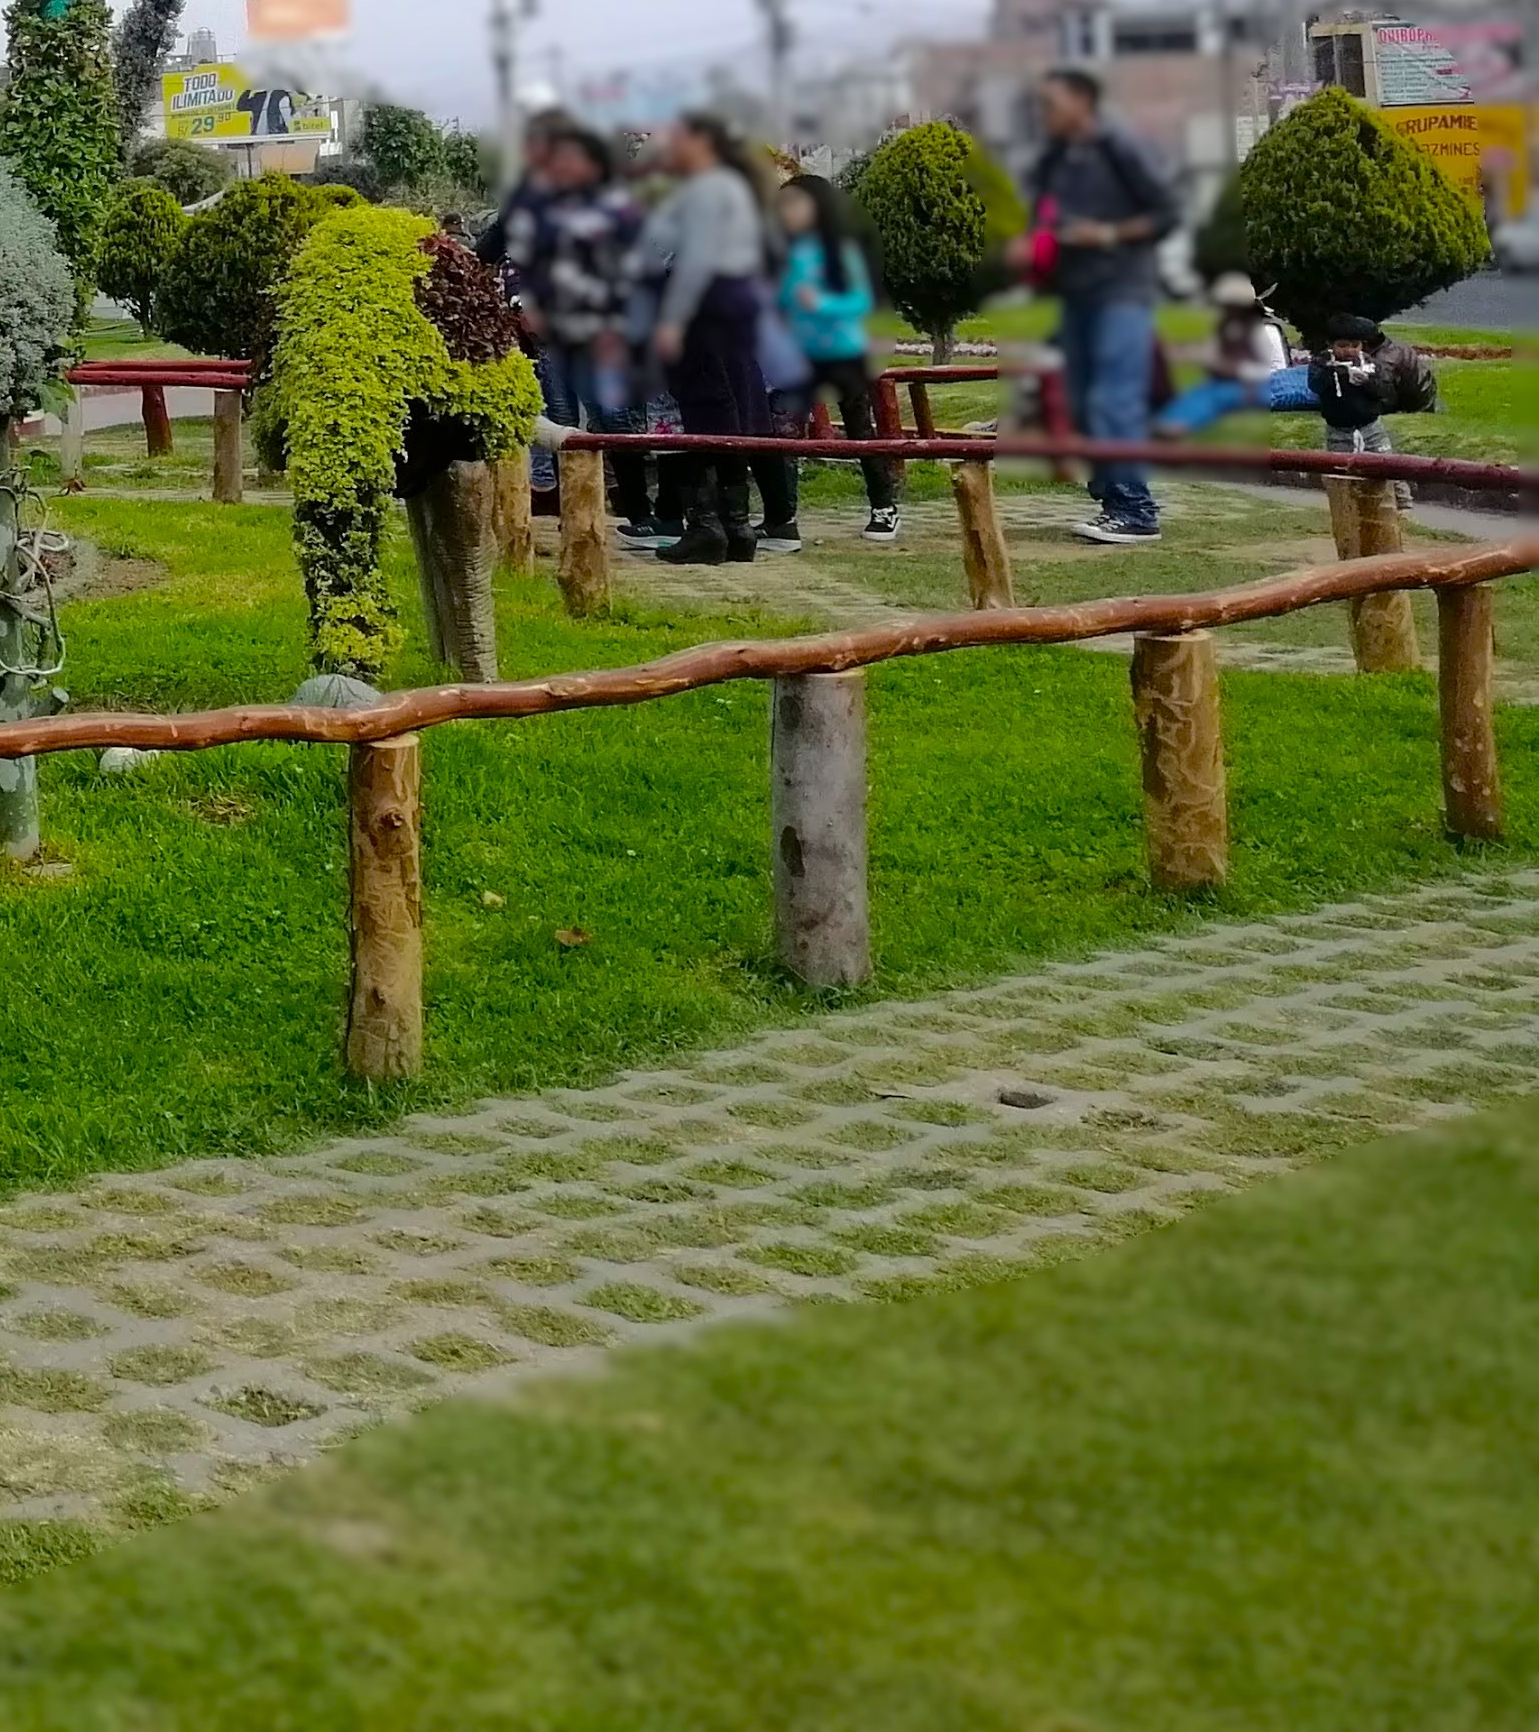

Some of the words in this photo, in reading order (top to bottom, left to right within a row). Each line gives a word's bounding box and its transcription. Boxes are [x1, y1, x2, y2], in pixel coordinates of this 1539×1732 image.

[184, 73, 217, 92] TODO
[172, 89, 233, 110] ILIMITADO
[191, 116, 215, 135] 29
